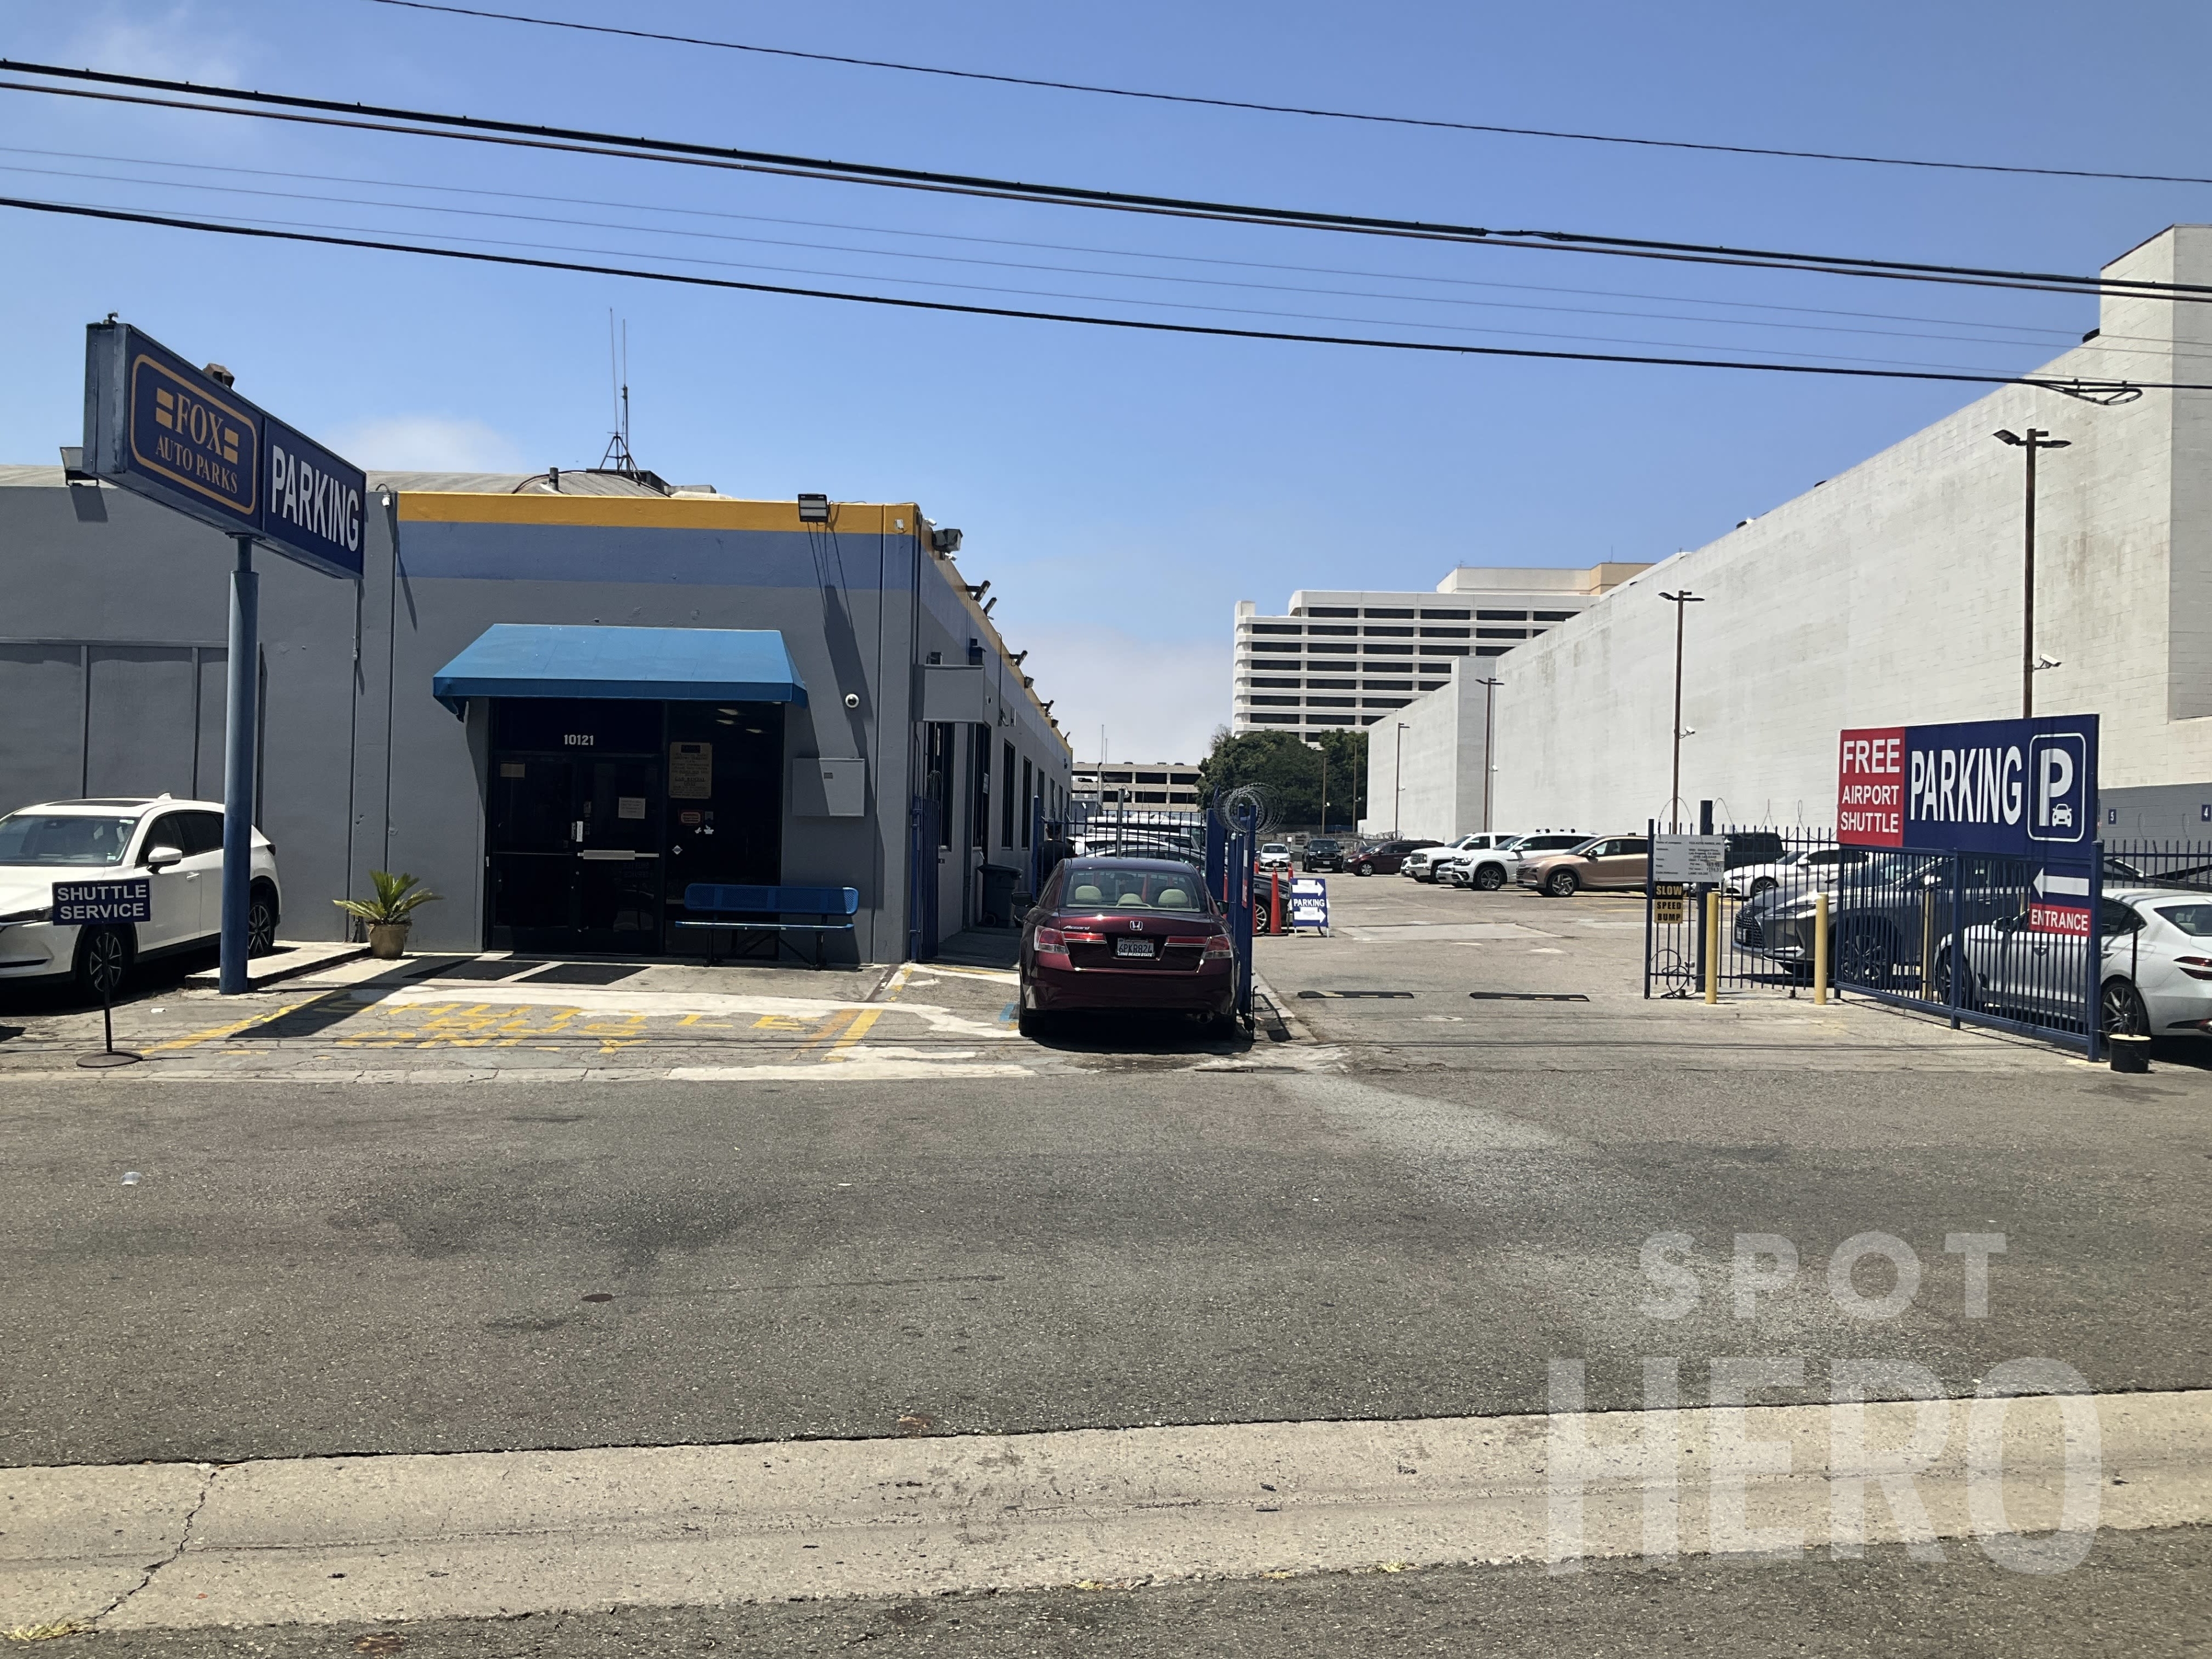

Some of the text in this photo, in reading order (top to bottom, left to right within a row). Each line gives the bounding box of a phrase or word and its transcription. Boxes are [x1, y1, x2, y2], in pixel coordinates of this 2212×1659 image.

[175, 392, 224, 456] FOX
[156, 434, 238, 494] AUTO PARKS
[272, 445, 359, 551] PARKING
[564, 734, 594, 745] 10121
[1843, 738, 1900, 774] FREE
[1842, 785, 1900, 805] AIRPORT
[1910, 746, 2022, 825] PARKING
[2039, 748, 2073, 826] P
[1841, 812, 1899, 833] SHUTTLE
[2110, 811, 2115, 821] 5
[2204, 807, 2209, 818] 4
[58, 885, 147, 901] SHUTTLE
[1656, 885, 1682, 895] SLOW
[60, 903, 144, 919] SERVICE
[2031, 909, 2089, 931] ENTRANCE
